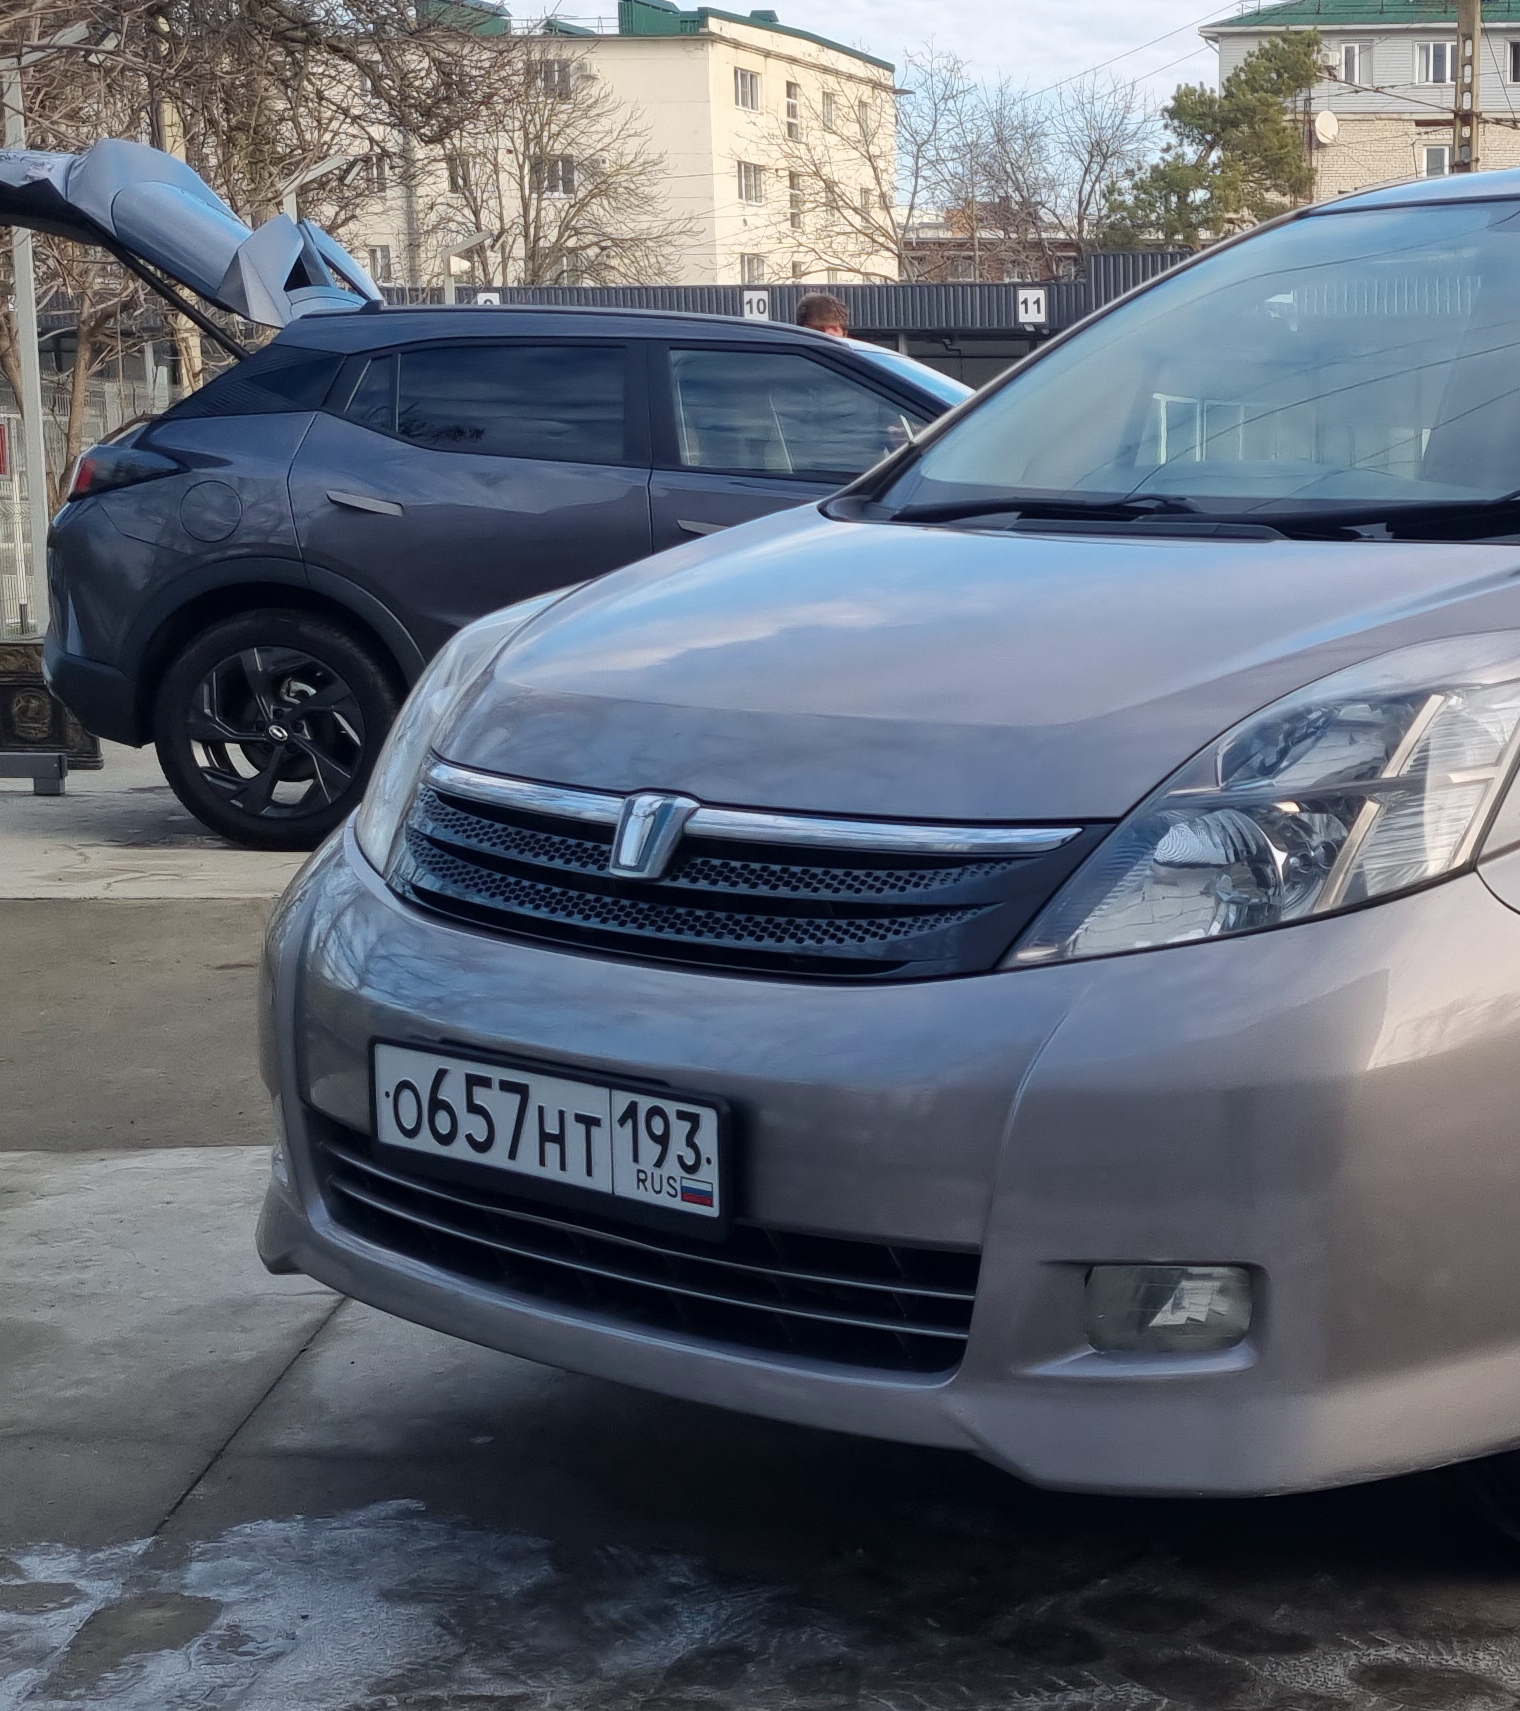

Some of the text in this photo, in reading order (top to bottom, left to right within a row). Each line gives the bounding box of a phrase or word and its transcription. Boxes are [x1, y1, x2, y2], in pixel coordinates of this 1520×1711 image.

[745, 298, 767, 314] 10
[1021, 297, 1041, 314] 11
[617, 1100, 703, 1175] 193
[636, 1168, 678, 1198] RUS
